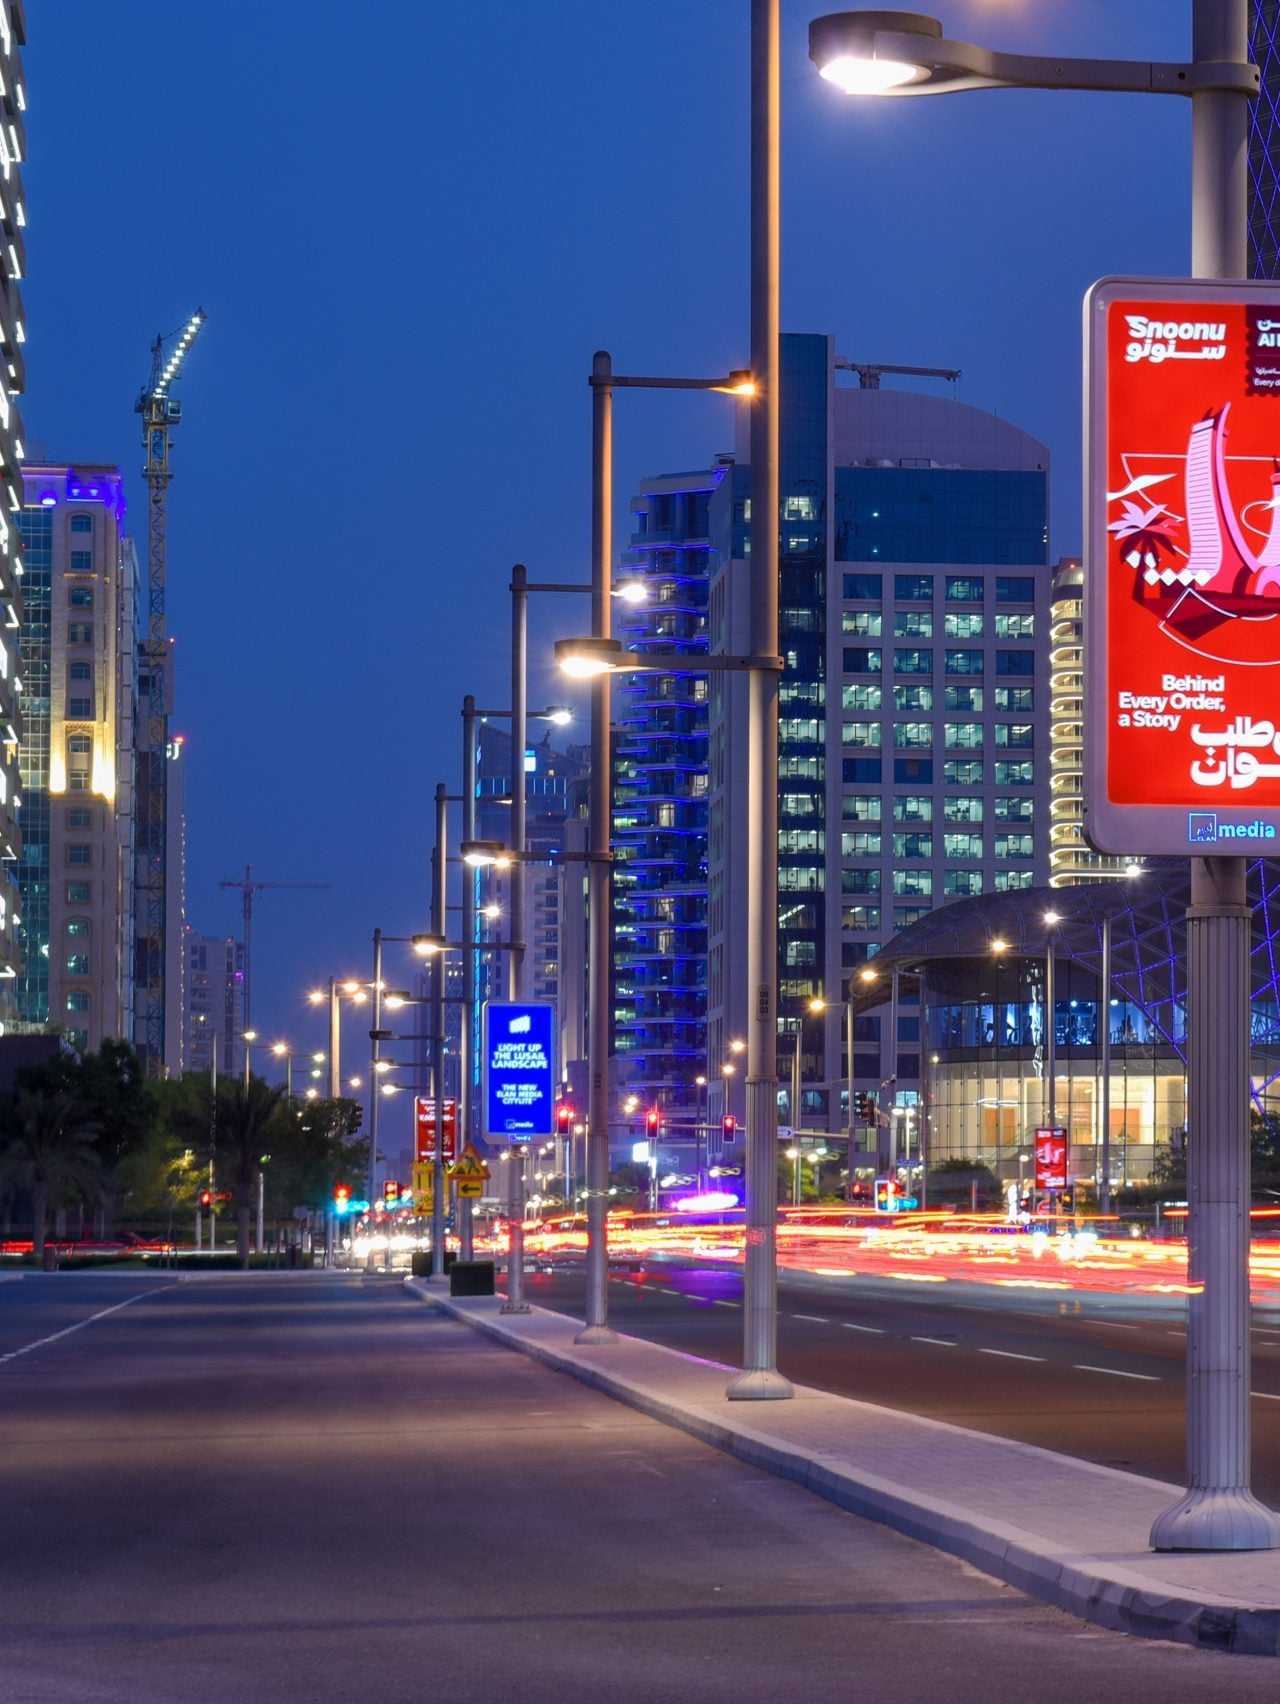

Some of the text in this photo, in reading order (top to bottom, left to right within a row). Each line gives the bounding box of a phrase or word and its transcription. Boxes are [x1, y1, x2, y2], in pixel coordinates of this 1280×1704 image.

[1124, 315, 1227, 341] Snoonu
[1258, 333, 1275, 348] Al
[1254, 378, 1274, 388] Every
[1162, 675, 1225, 692] Behind
[1119, 692, 1226, 713] Every Order,
[1118, 712, 1182, 732] a Story
[1190, 716, 1275, 756] طلب
[1218, 820, 1275, 838] media
[494, 1051, 546, 1060] THE LUSAIL
[498, 1043, 542, 1052] LIGHT UP
[492, 1060, 548, 1069] LANDSCAPE
